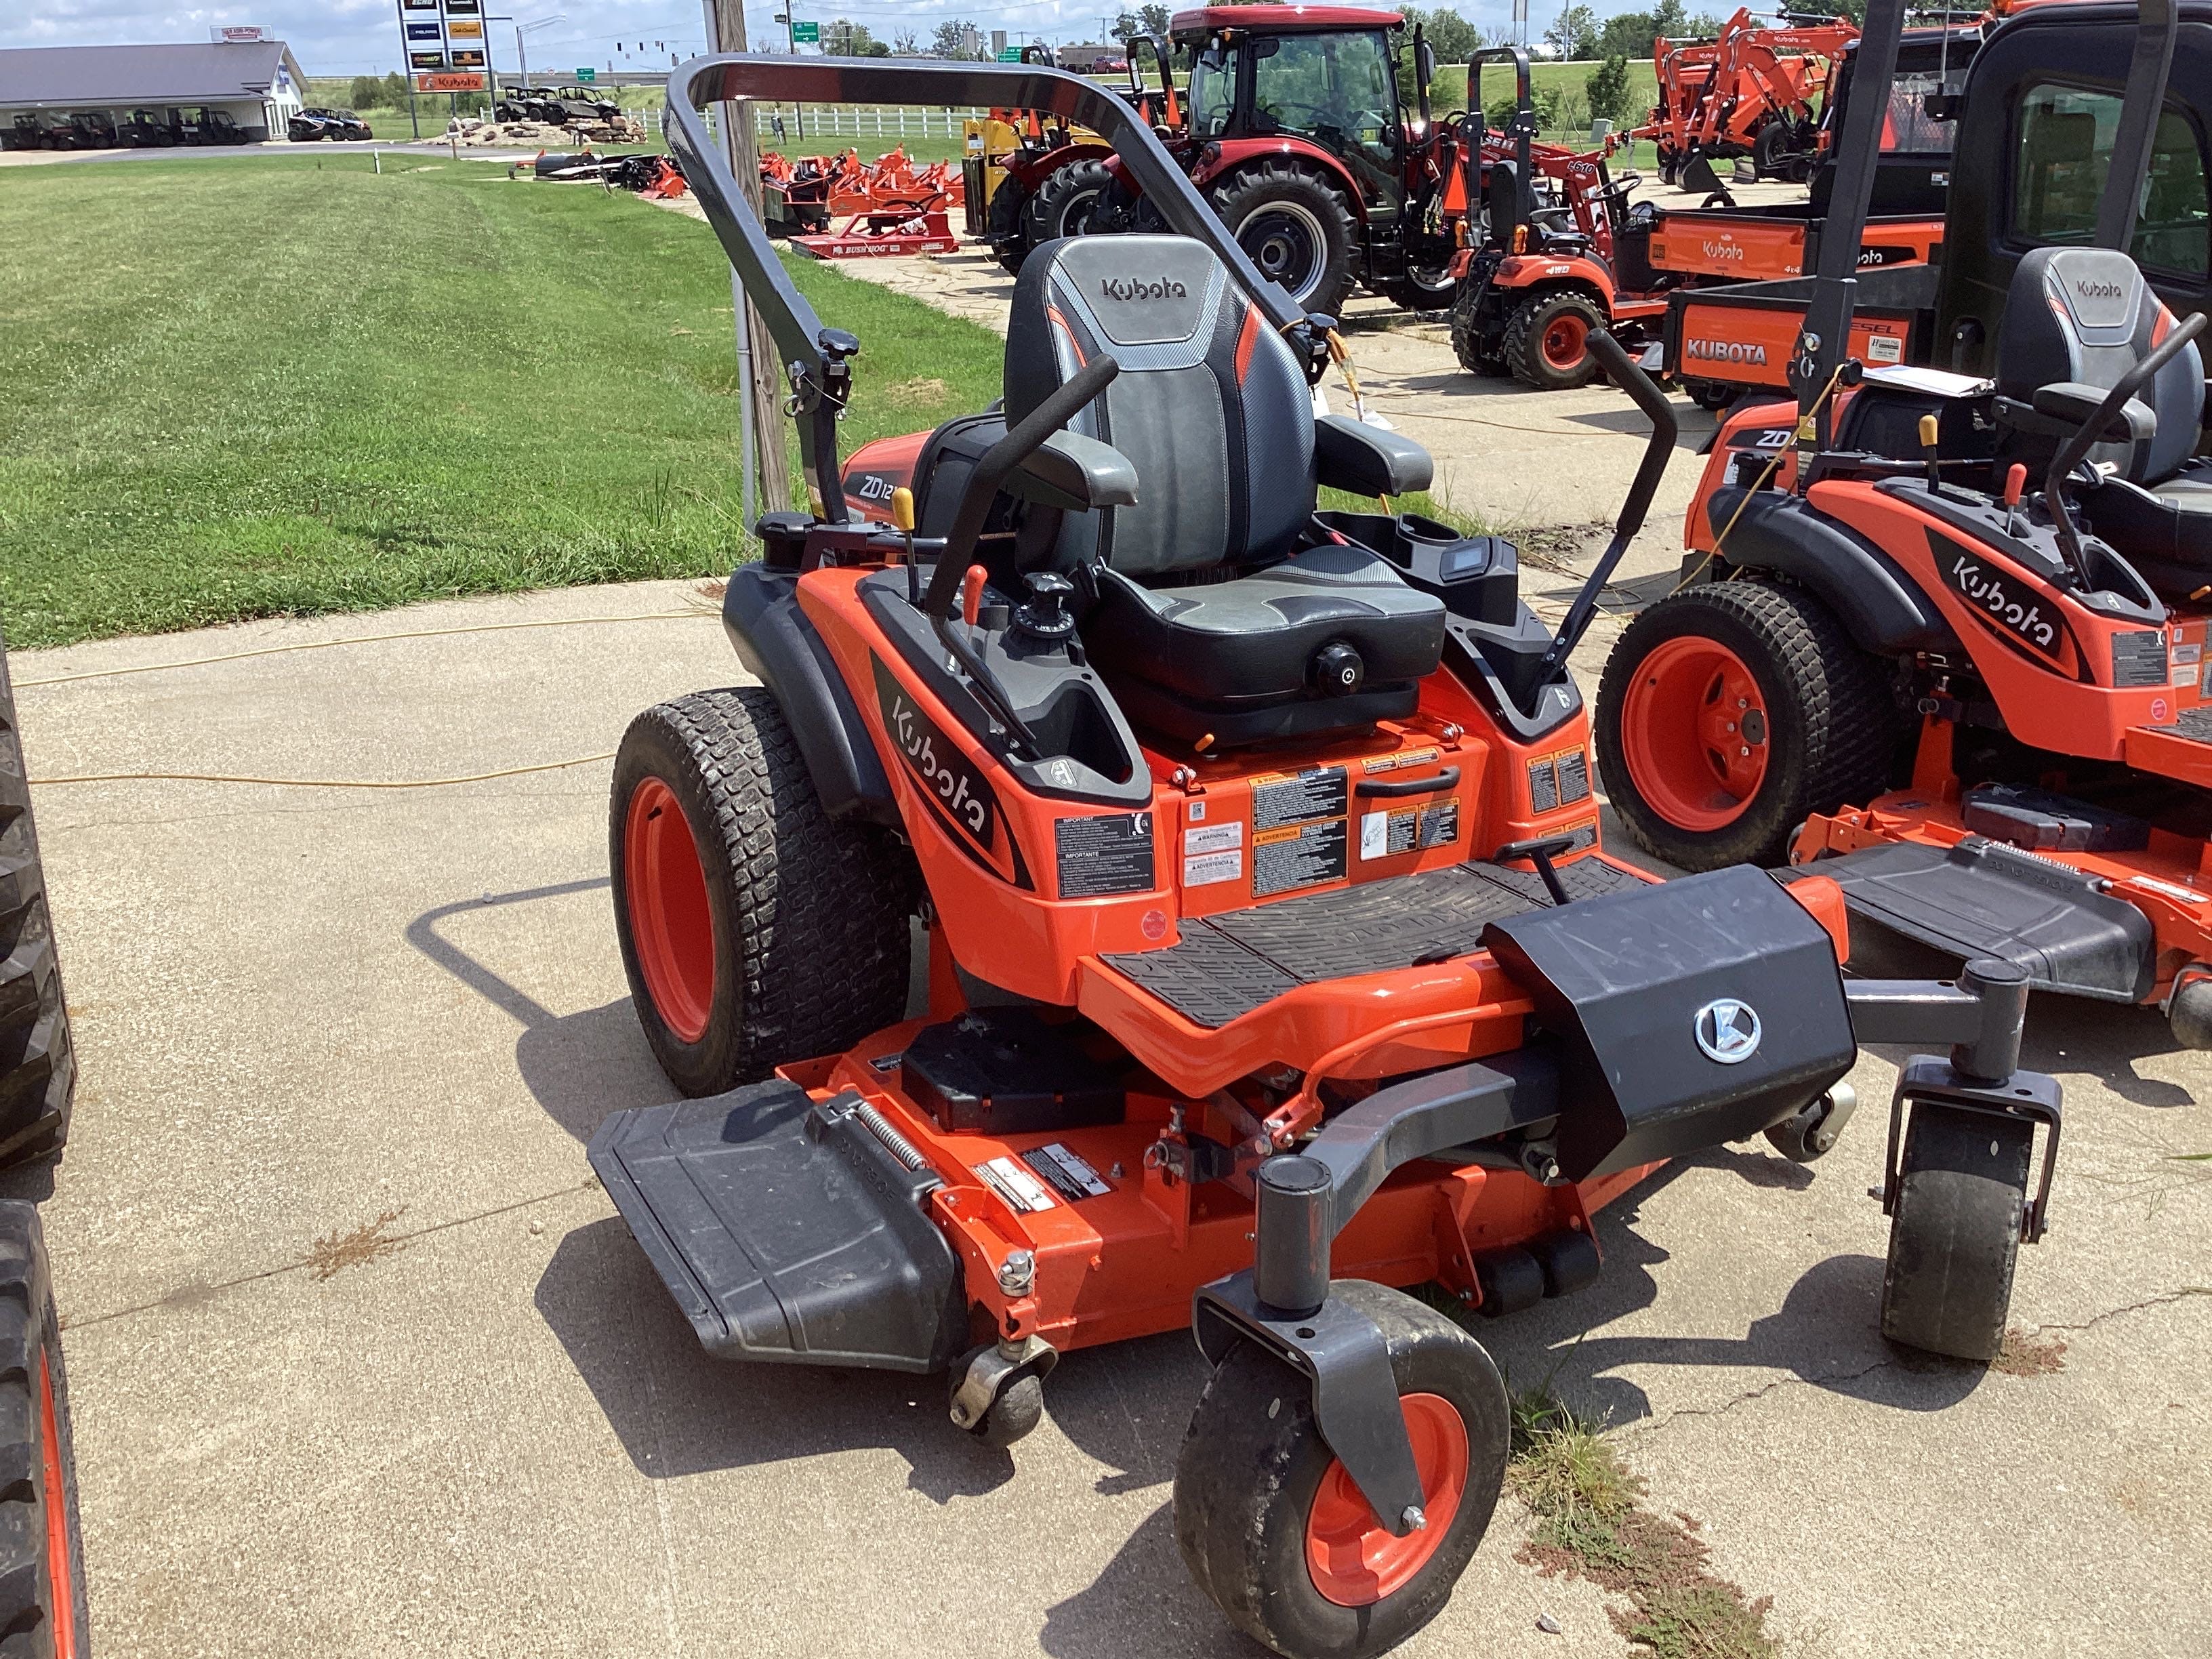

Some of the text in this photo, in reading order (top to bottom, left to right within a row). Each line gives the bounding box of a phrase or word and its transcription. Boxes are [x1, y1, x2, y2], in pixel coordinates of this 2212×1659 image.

[438, 77, 478, 87] Kubota
[1567, 161, 1595, 174] L610
[844, 245, 866, 254] BUSH
[1702, 241, 1744, 261] Kubota
[1101, 276, 1187, 301] Kubota
[2076, 280, 2122, 298] Kubota
[1687, 338, 1767, 366] KUBOTA
[1952, 556, 2053, 646] Kubota
[893, 695, 985, 832] Kubota
